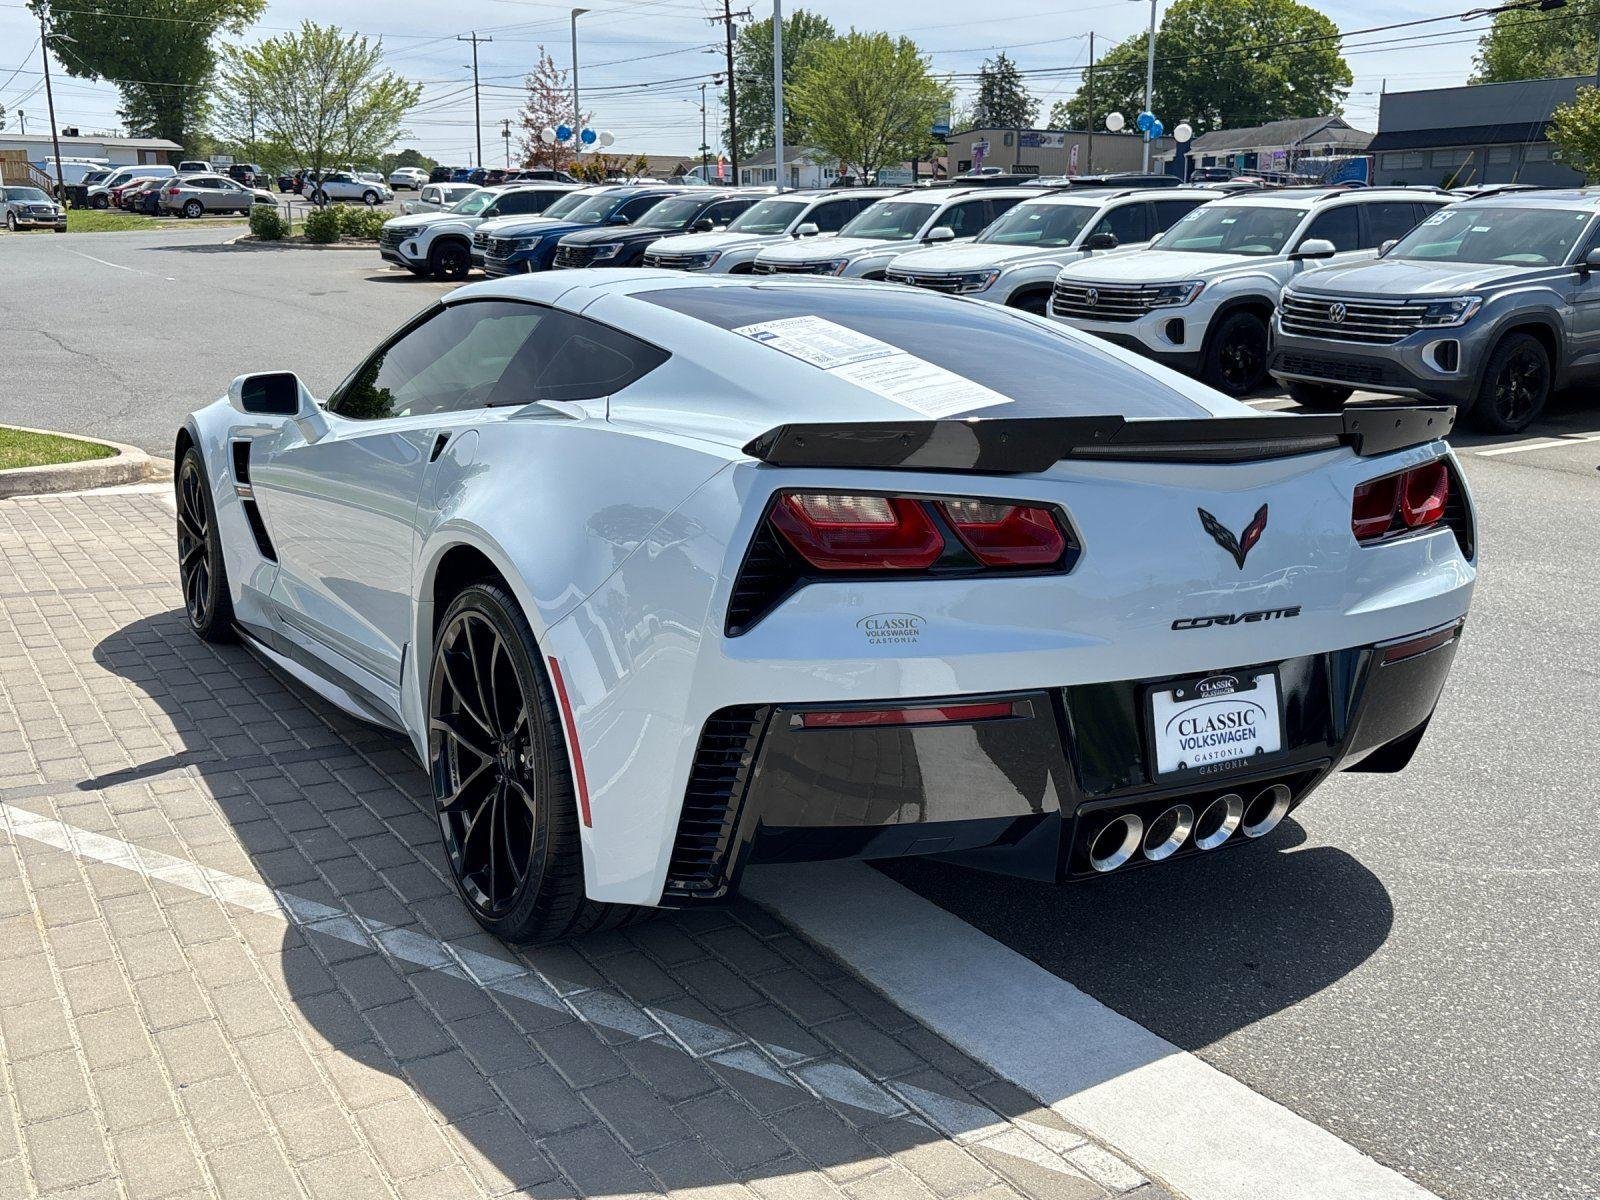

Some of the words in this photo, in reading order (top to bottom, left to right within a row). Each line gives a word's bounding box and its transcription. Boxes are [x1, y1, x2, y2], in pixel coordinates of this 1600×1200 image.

[865, 618, 918, 630] CLASSIC
[1171, 605, 1302, 631] CORVETTE
[865, 629, 920, 637] VOLKSWAGEN
[869, 637, 917, 645] GASTONIA
[1200, 678, 1234, 692] CLASSIC
[1200, 688, 1235, 698] VOLKSWAGEN
[1178, 709, 1255, 736] CLASSIC
[1179, 726, 1256, 751] VOLKSWAGEN
[1194, 747, 1244, 763] GASTONIA
[1199, 759, 1249, 775] GASTONIA
